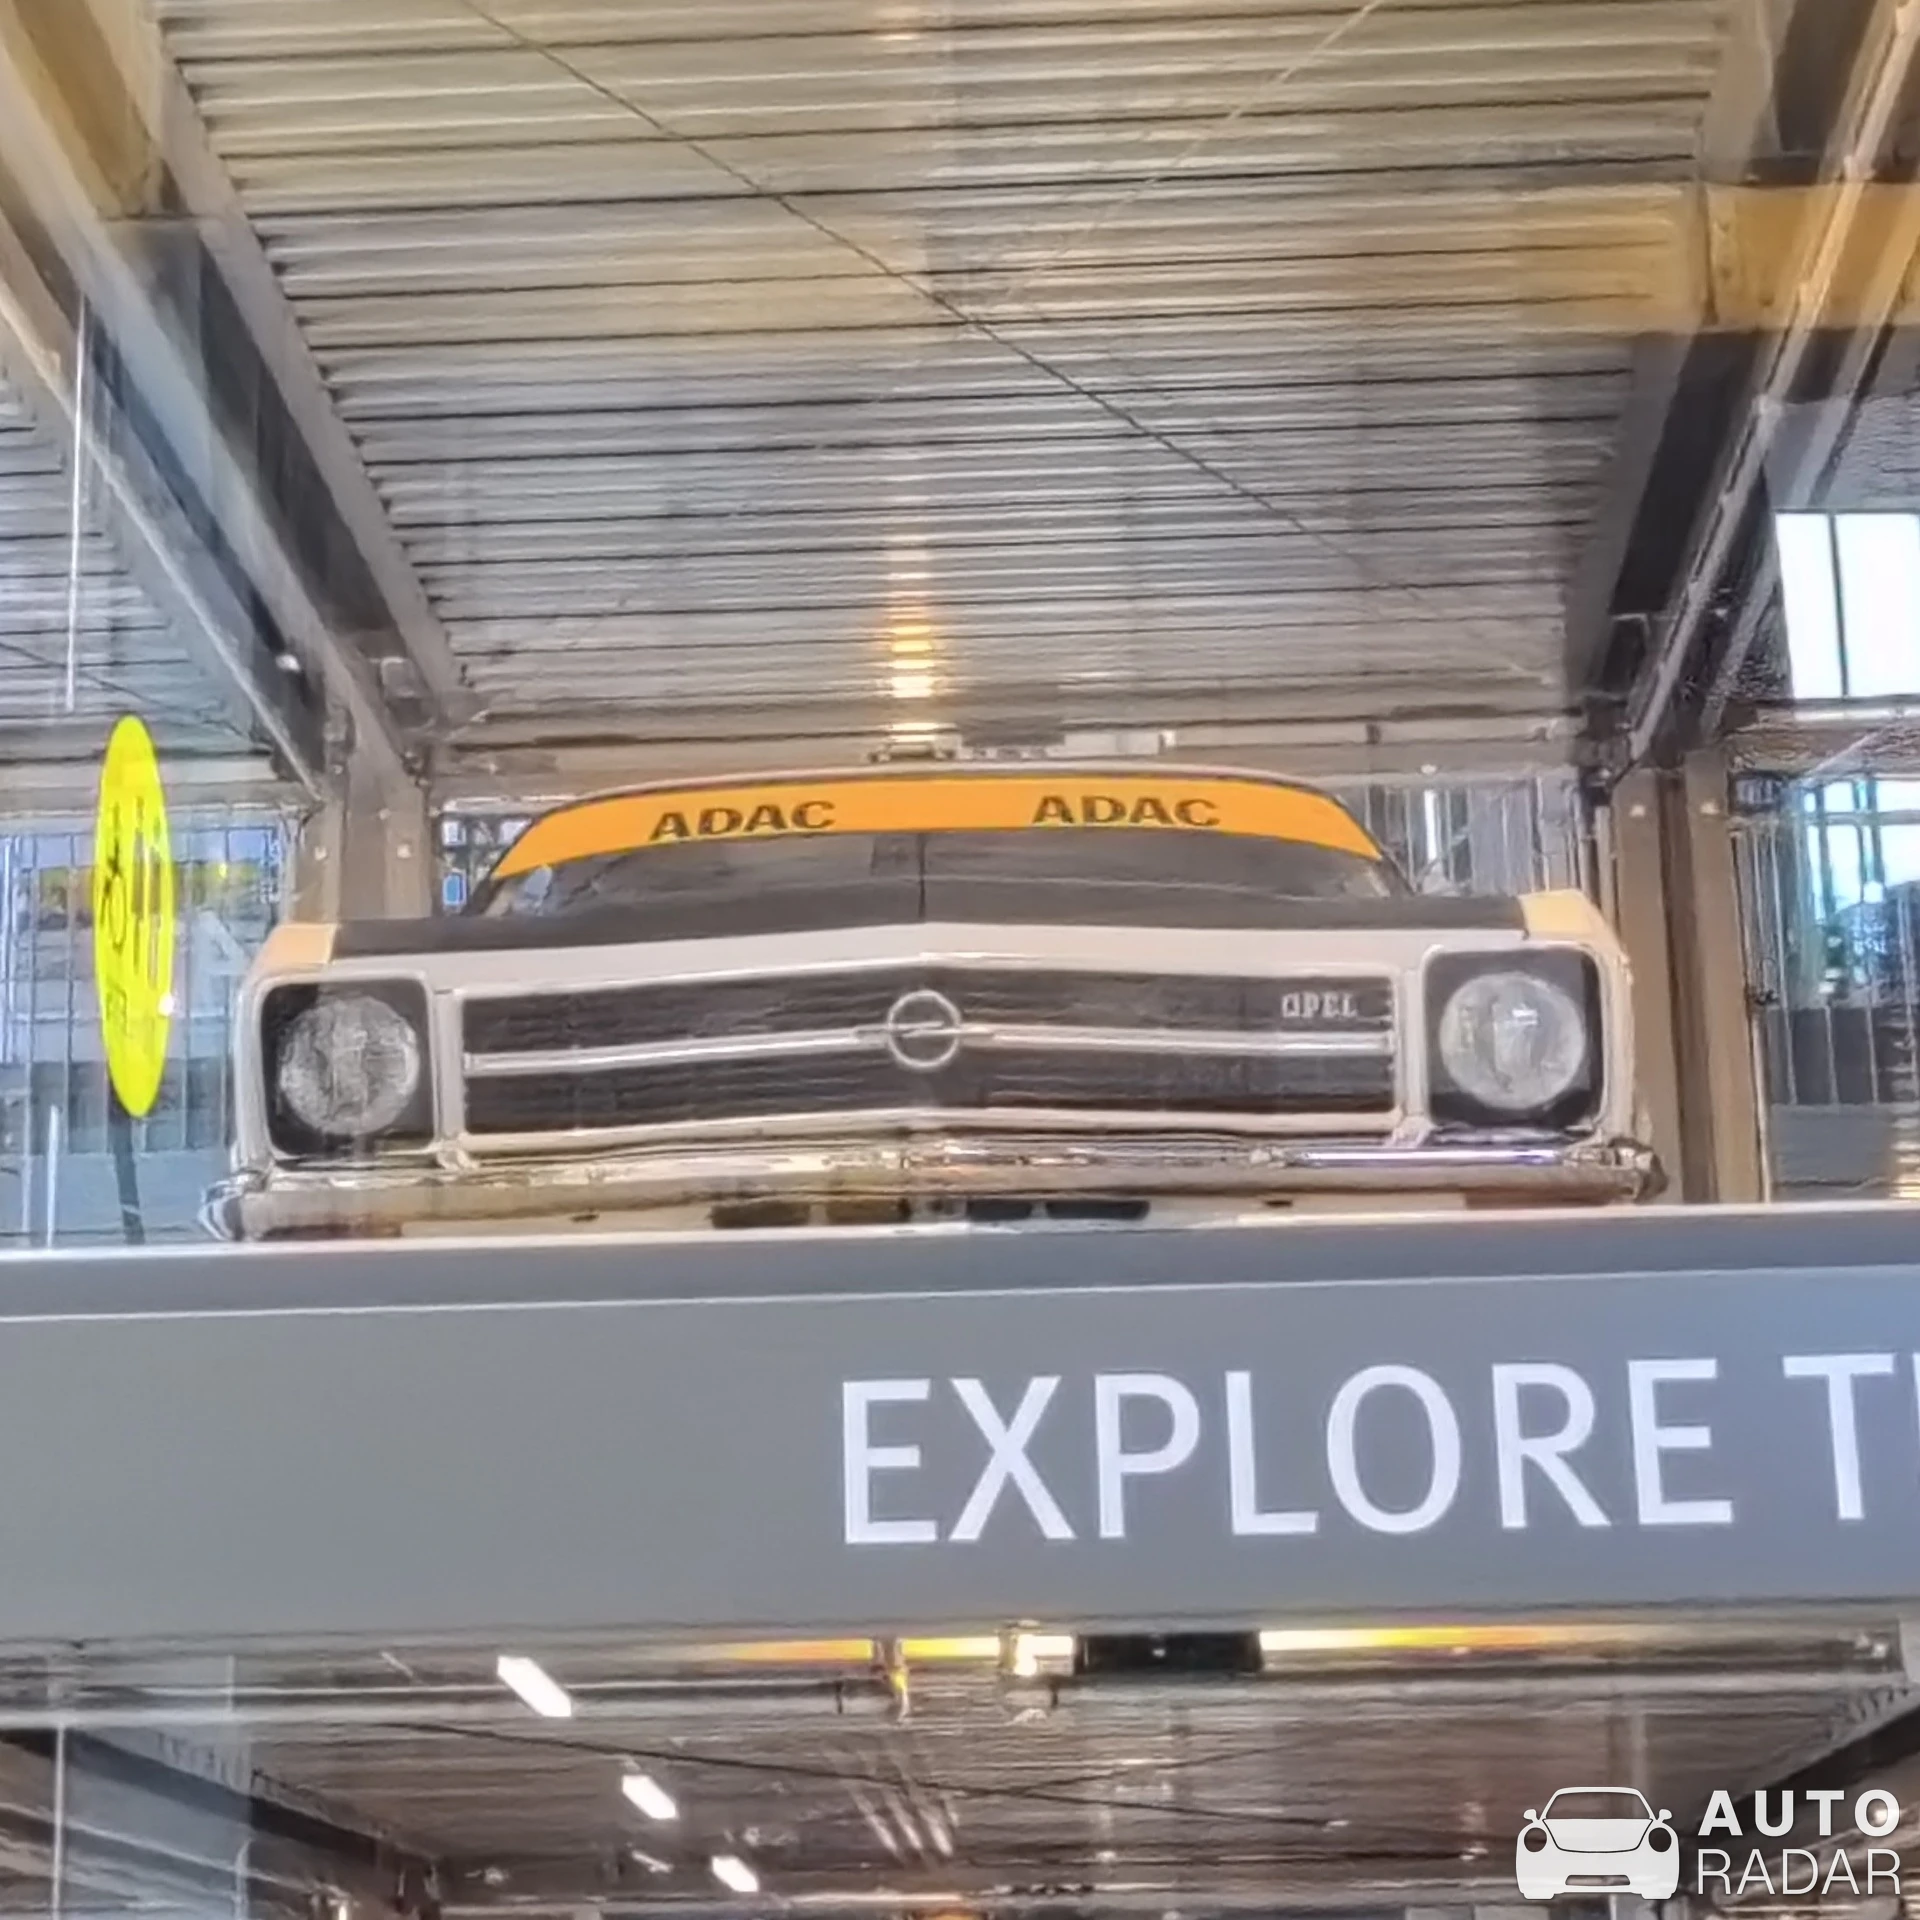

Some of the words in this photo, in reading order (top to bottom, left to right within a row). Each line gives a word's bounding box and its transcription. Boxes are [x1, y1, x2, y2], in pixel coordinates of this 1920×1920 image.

[650, 800, 836, 842] ADAC
[1032, 795, 1221, 827] ADAC
[1281, 990, 1358, 1019] OPEL
[841, 1357, 1735, 1545] EXPLORE
